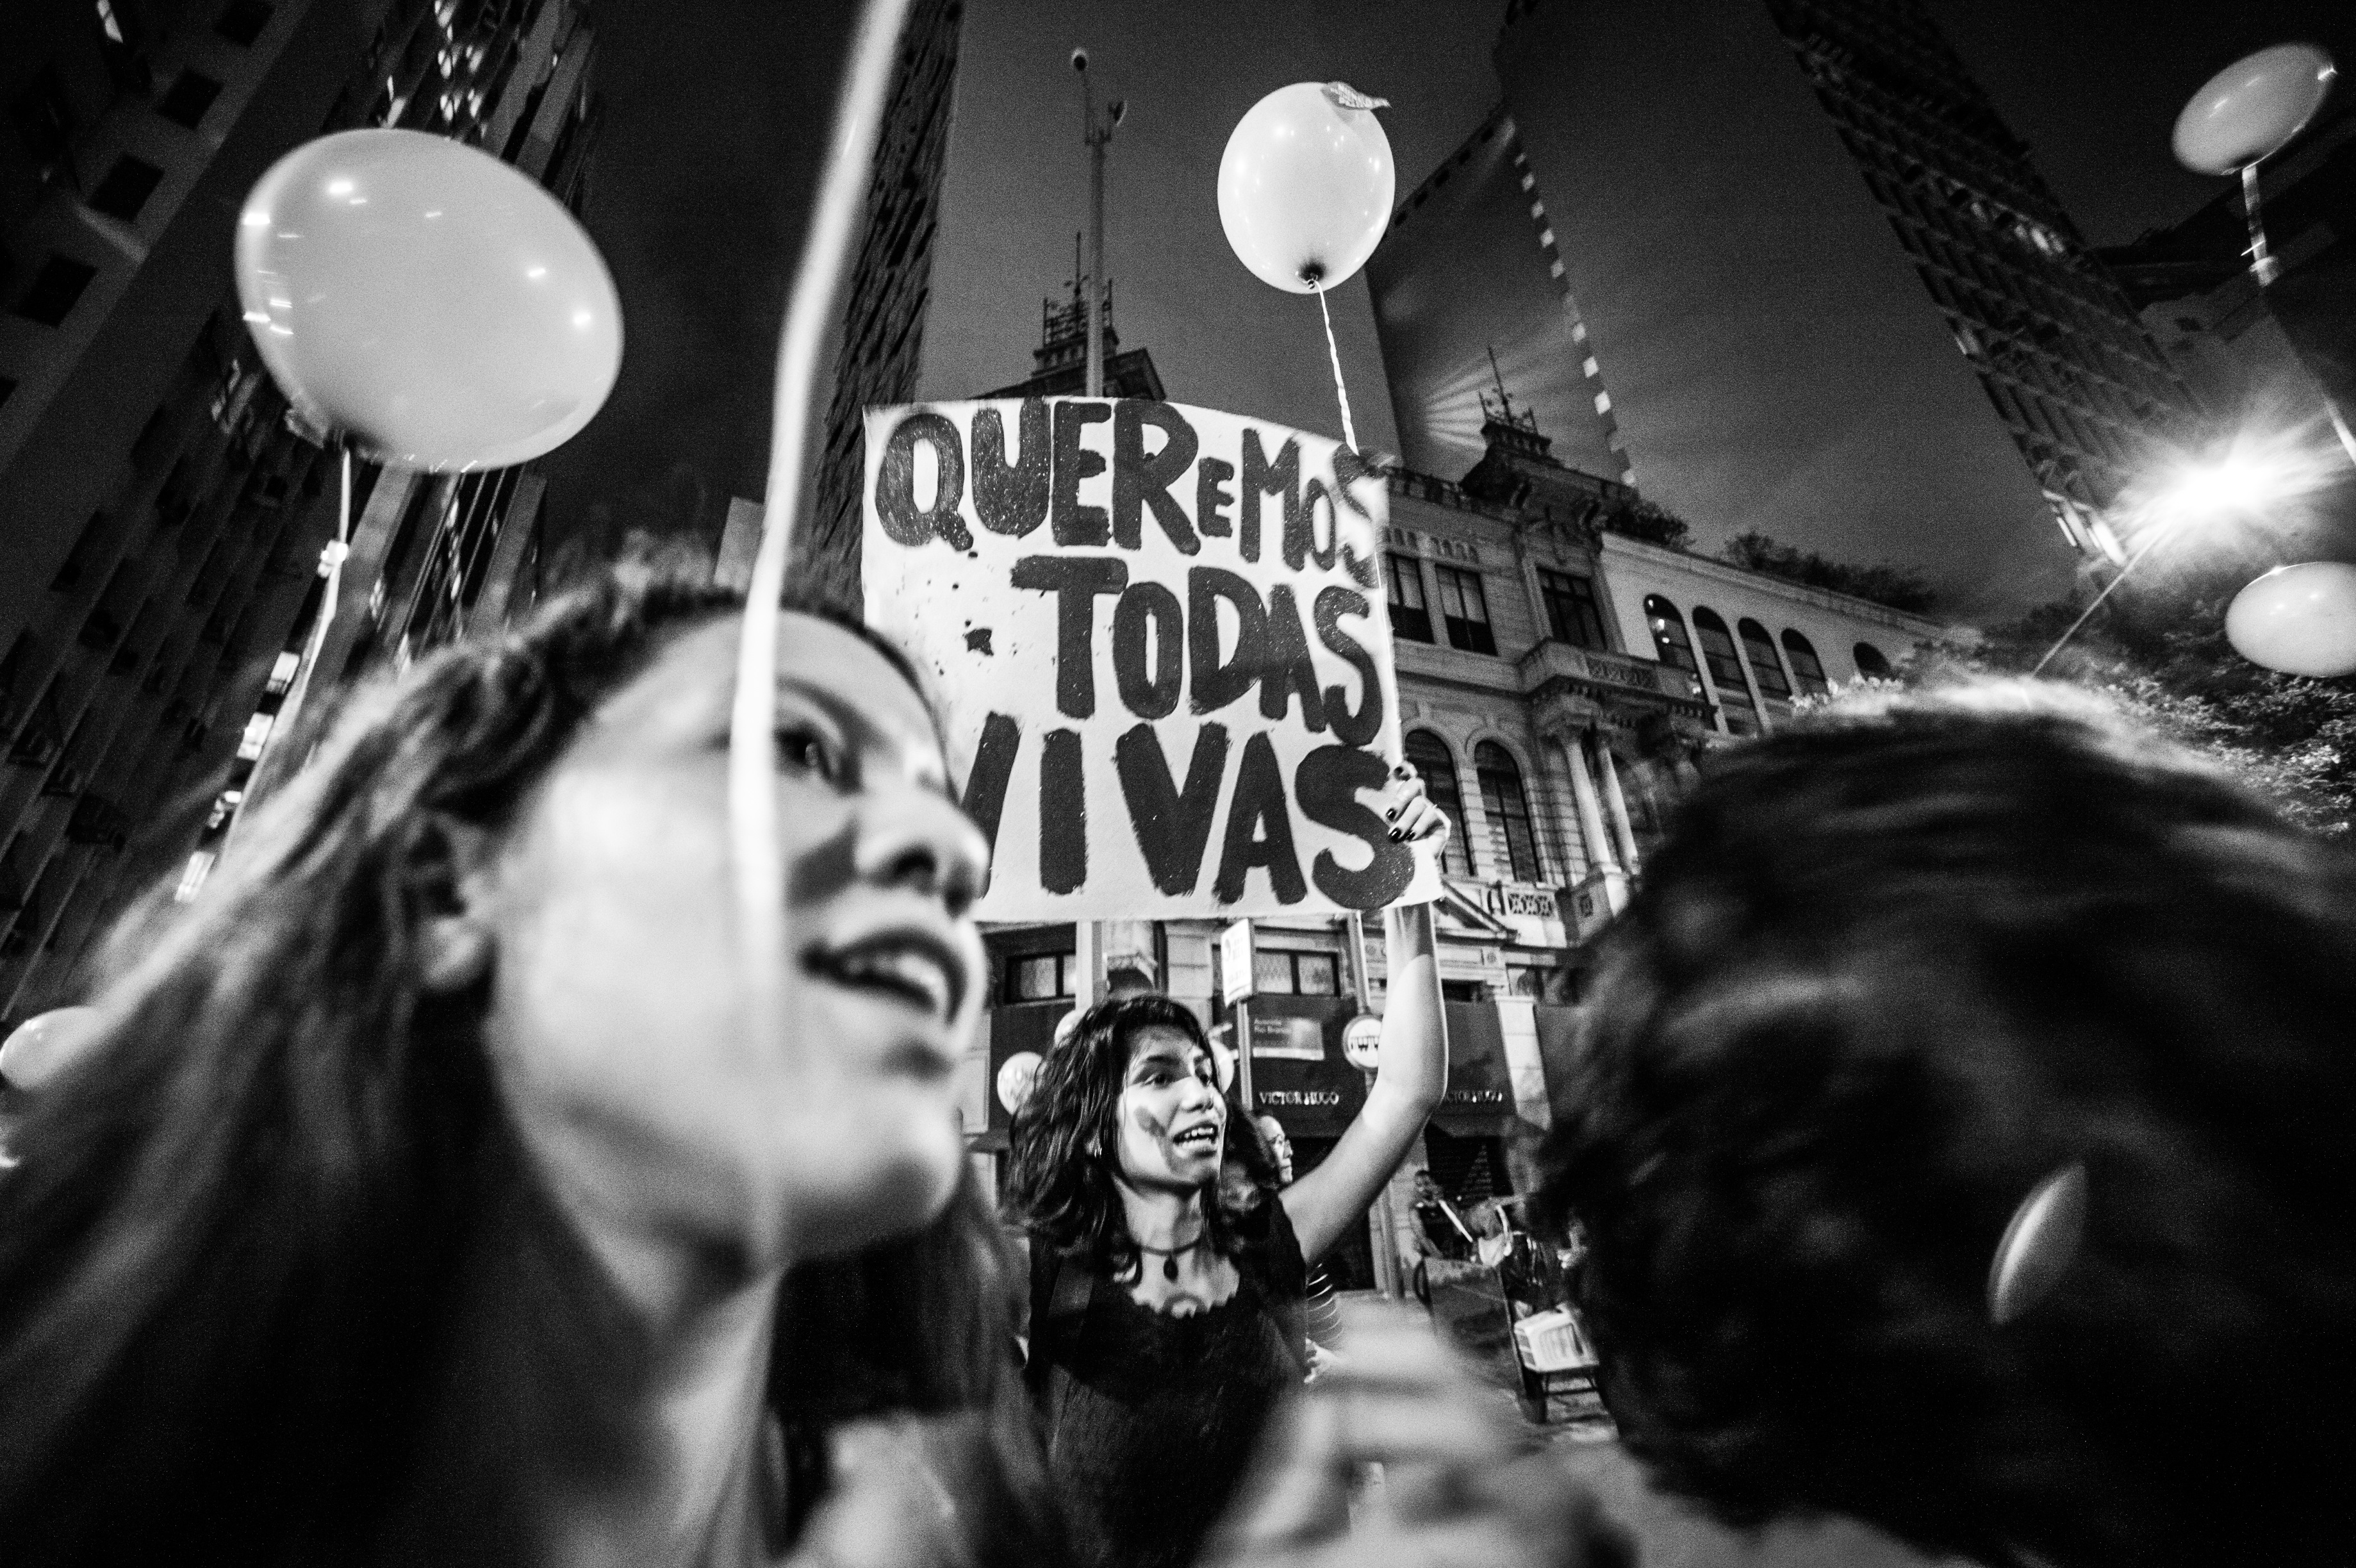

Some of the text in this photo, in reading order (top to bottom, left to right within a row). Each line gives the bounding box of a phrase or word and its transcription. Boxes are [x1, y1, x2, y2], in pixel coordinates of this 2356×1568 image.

[875, 395, 1384, 588] QUEREMOS
[1010, 555, 1382, 746] TODAS
[1259, 1091, 1302, 1105] VICTOR
